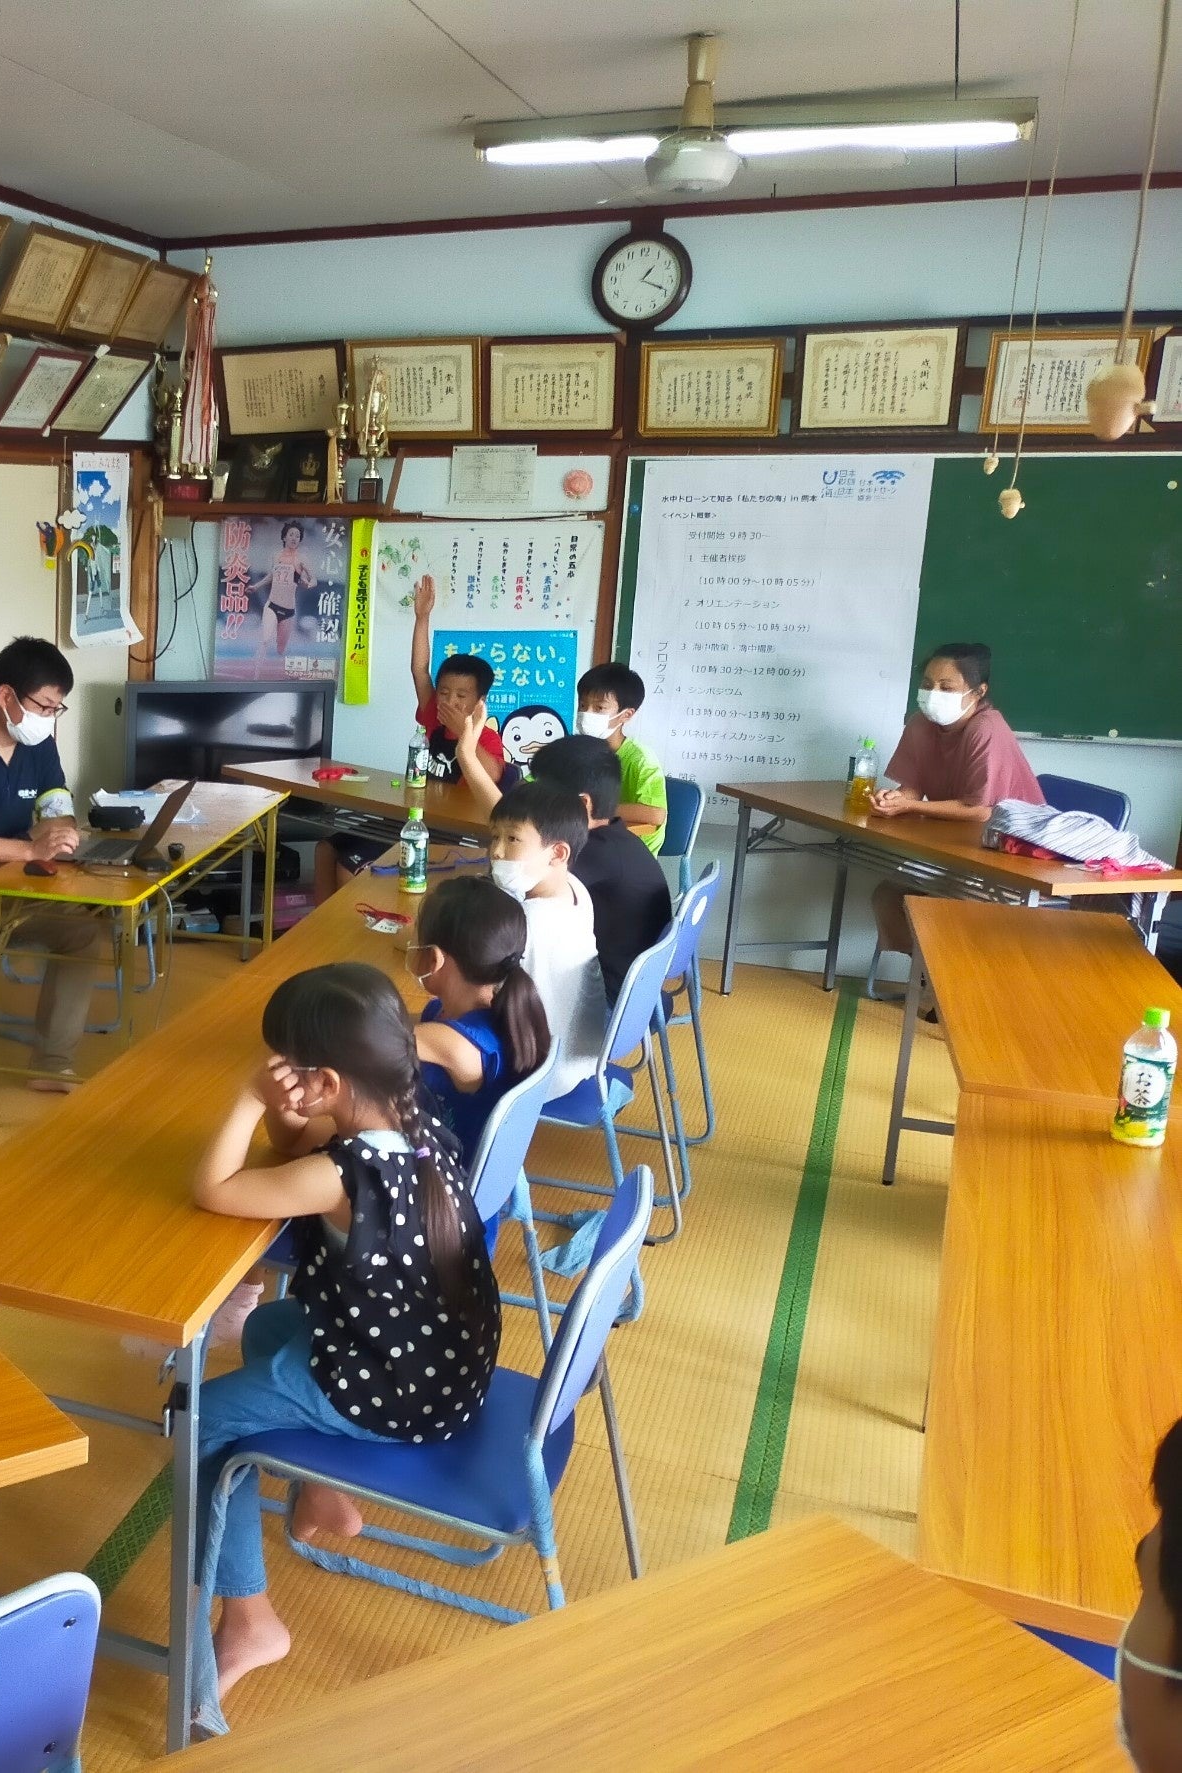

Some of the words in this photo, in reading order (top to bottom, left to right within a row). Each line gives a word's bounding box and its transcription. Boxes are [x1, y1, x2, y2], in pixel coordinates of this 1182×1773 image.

[627, 251, 635, 260] 11
[640, 247, 651, 257] 12
[615, 262, 625, 272] 10
[610, 276, 617, 285] 9
[623, 300, 629, 310] 7
[635, 303, 642, 313] 6
[790, 495, 799, 503] in
[567, 535, 579, 578] 日常の五心
[316, 522, 347, 643] 安心・確認
[353, 564, 369, 650] 子ども見守りパトロール
[695, 599, 781, 610] オリエンテーション
[443, 642, 567, 664] もどらない。
[652, 640, 669, 695] プログラム
[493, 666, 566, 688] さない。
[688, 685, 743, 696] シンポジウム
[682, 729, 786, 743] パネルディスカッション
